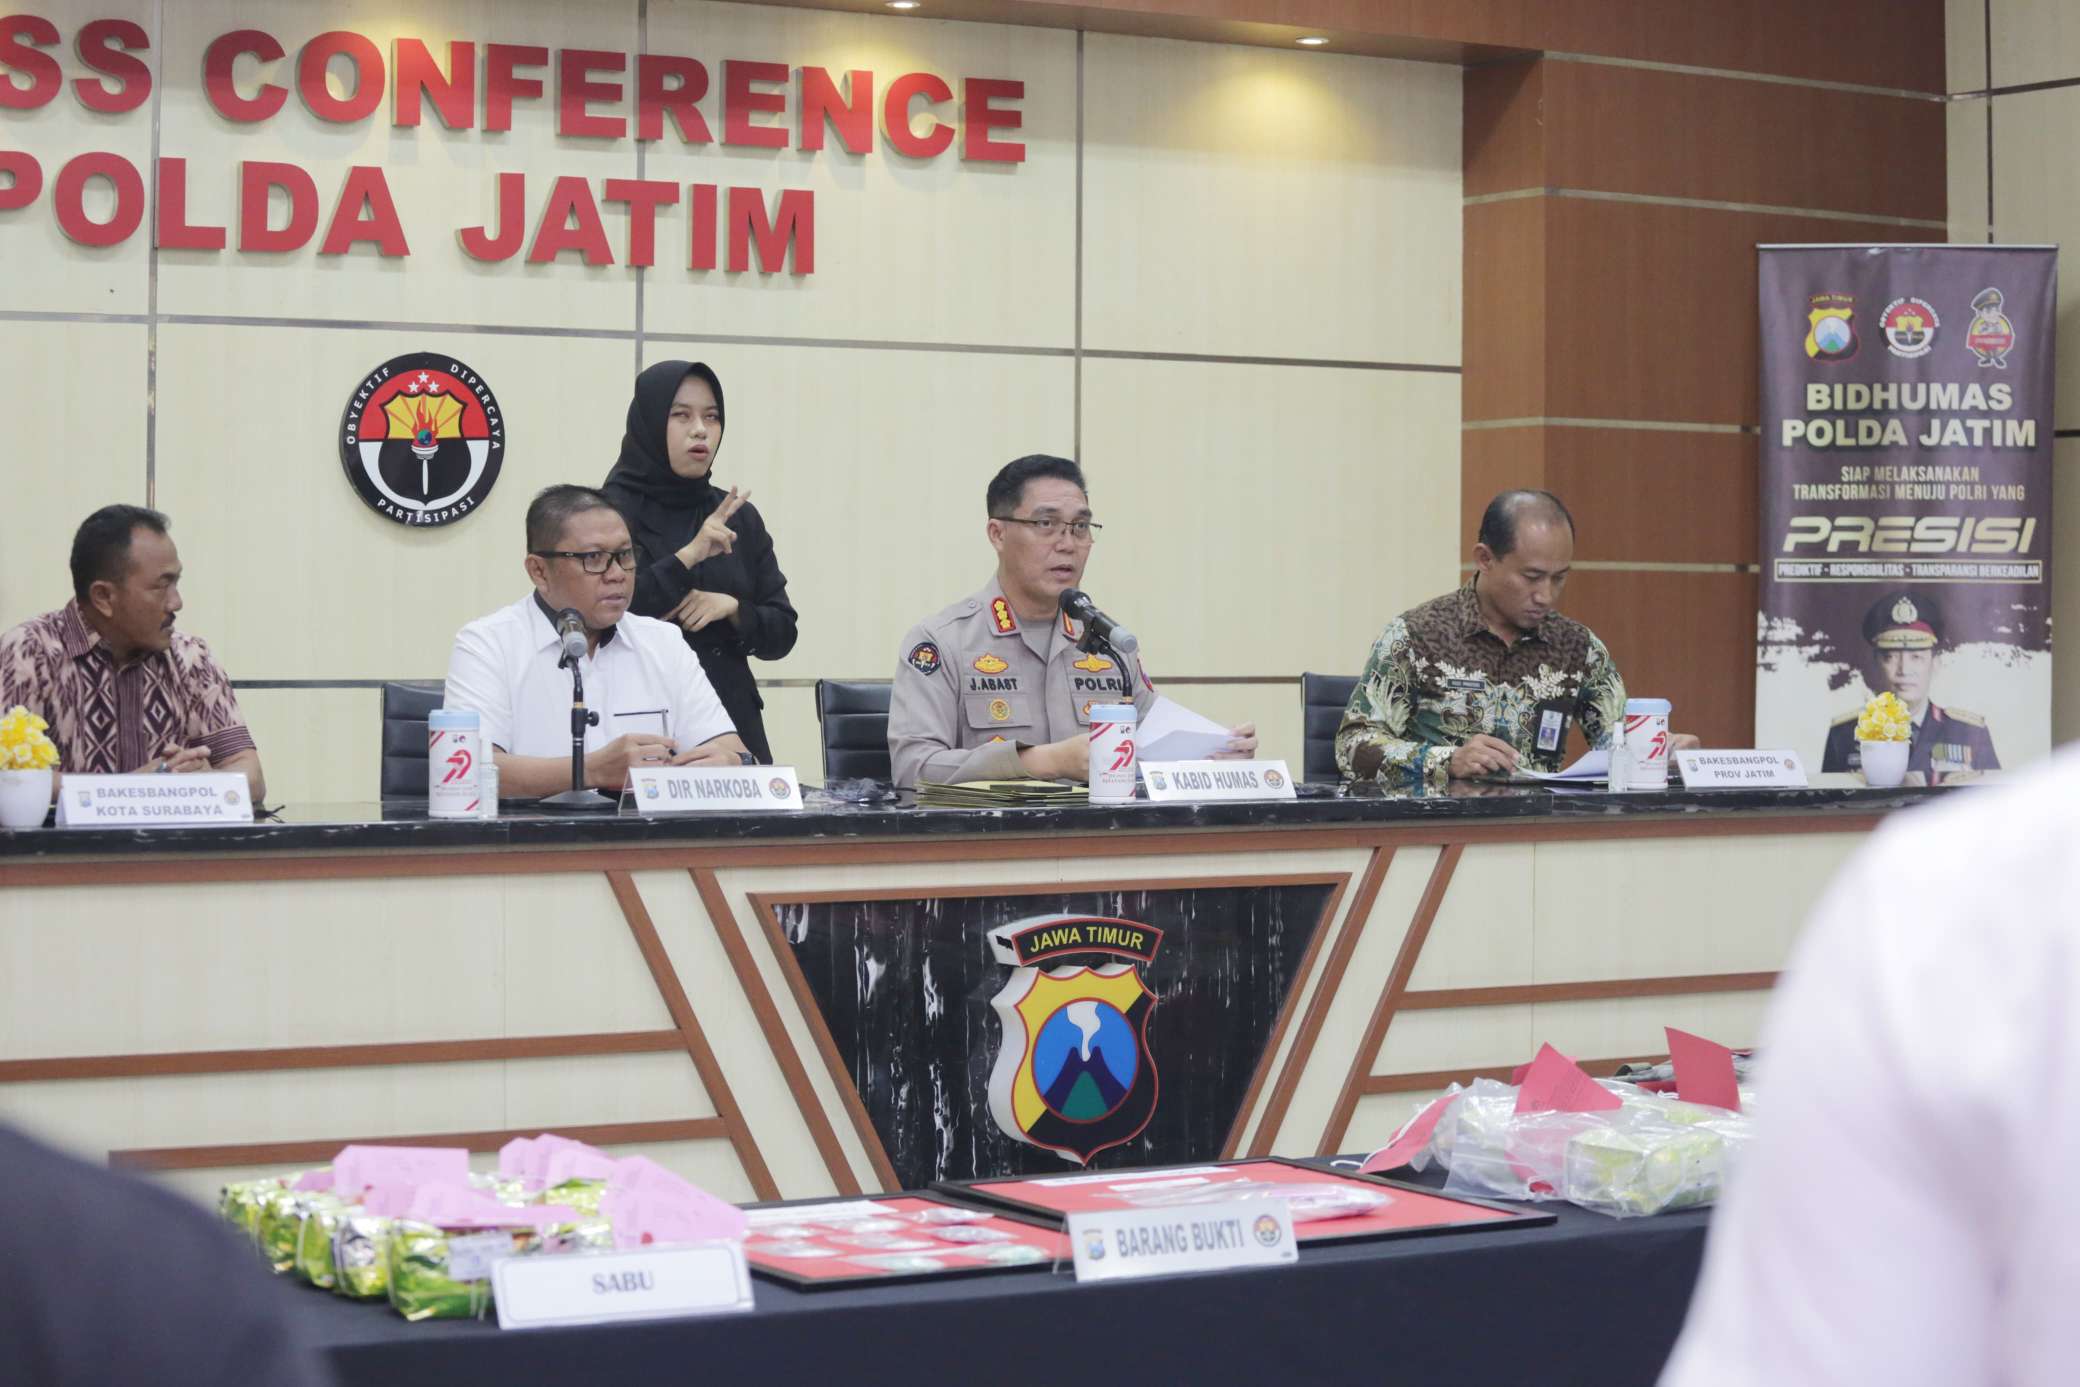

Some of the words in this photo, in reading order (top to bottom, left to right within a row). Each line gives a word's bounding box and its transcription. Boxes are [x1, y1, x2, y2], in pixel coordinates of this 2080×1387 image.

[203, 28, 1027, 164] CONFERENCE
[455, 172, 815, 275] JATIM
[346, 367, 390, 445] OBYEKTIF
[450, 363, 501, 450] DIPERCAYA
[1806, 382, 2013, 412] BIDHUMAS
[1782, 418, 1908, 447] POLDA
[1918, 419, 2036, 448] JATIM
[1841, 466, 1870, 482] SIAP
[1874, 466, 1980, 482] MELAKSANAKAN
[1792, 484, 1891, 500] TRANSFORMASI
[1894, 484, 1946, 500] MENUJU
[1950, 484, 1987, 500] POLRI
[1991, 484, 2025, 501] YANG
[377, 496, 475, 523] PARTISIPASI
[1782, 515, 2037, 554] PRESISI
[1074, 677, 1123, 691] POLRI
[1699, 755, 1780, 765] BAKESBANGPOL
[1172, 772, 1212, 790] KABID
[1214, 771, 1259, 790] HUMAS
[1714, 769, 1741, 779] PROV
[1744, 769, 1775, 779] JATIM
[96, 786, 218, 799] BAKESBANGPOL
[667, 779, 691, 799] DIR
[696, 778, 762, 799] NARKOBA
[96, 805, 138, 817] KOTA
[143, 804, 224, 817] SURABAYA
[1030, 927, 1081, 953] JAWA
[1086, 926, 1144, 950] TIMUR
[1116, 1223, 1189, 1258] BARANG
[1192, 1219, 1245, 1251] BUKTI
[592, 1271, 655, 1294] SABU
